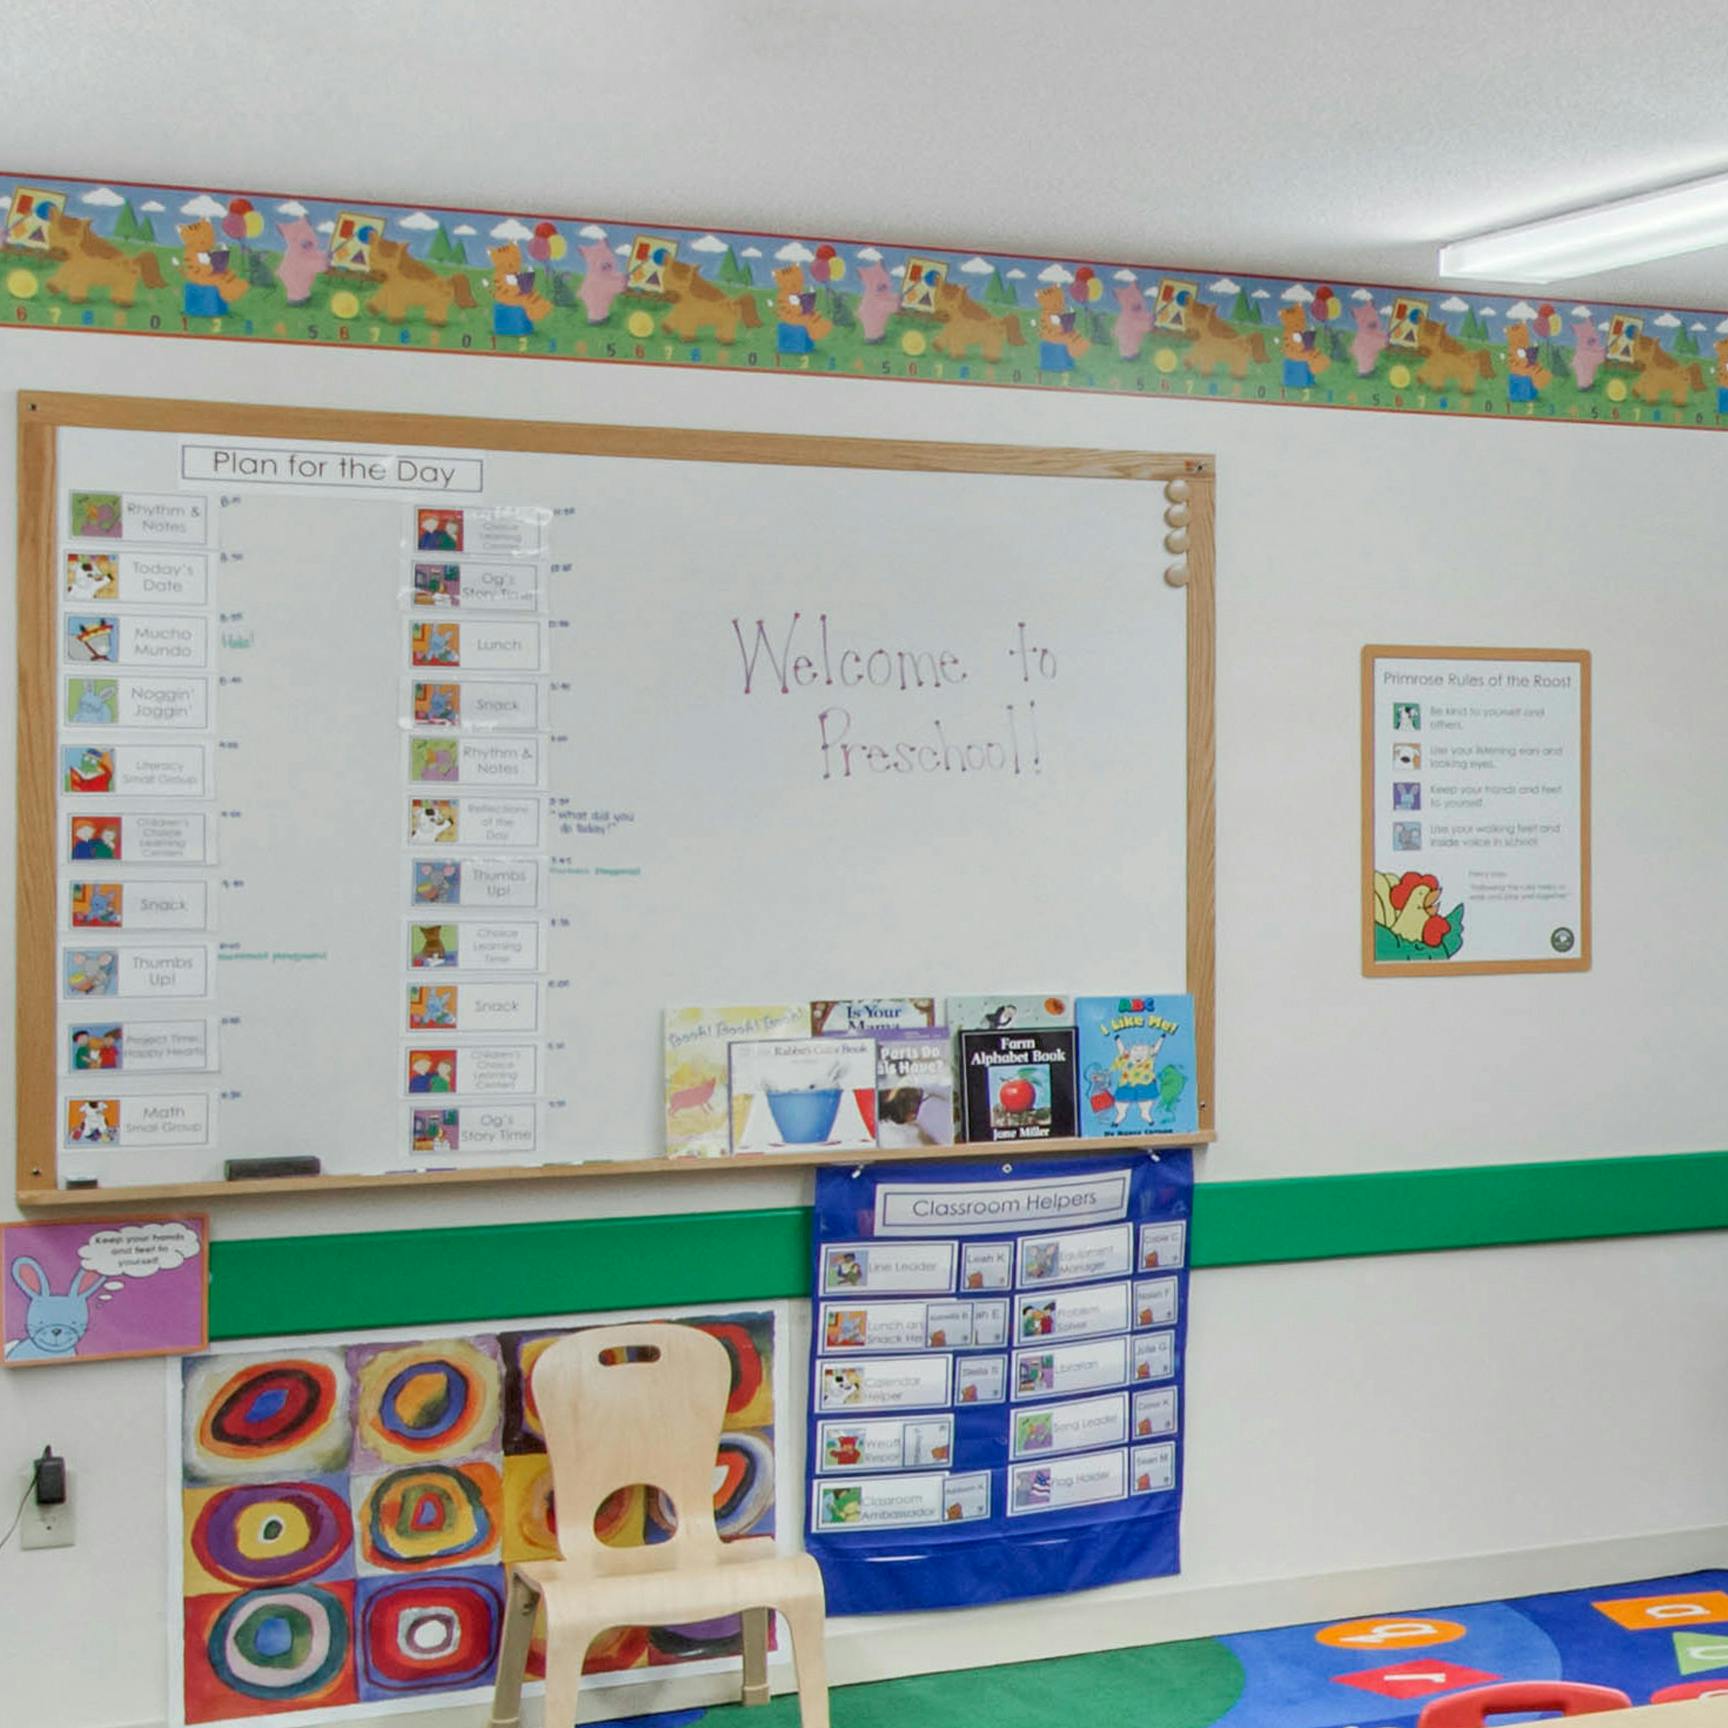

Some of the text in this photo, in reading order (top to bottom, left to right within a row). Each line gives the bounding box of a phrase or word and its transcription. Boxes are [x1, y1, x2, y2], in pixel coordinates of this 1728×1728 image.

[213, 450, 456, 489] Plan for the Day
[127, 501, 186, 518] Rhythm
[143, 519, 187, 534] Notes
[133, 560, 195, 577] Today's
[143, 579, 183, 594] Date
[134, 627, 192, 641] Mucho
[134, 644, 192, 658] Mundo
[477, 638, 521, 651] Lunch
[732, 611, 1058, 695] Welcome to
[1384, 670, 1572, 689] Primrose Rules of the Roost
[475, 699, 519, 712] Snack
[463, 746, 518, 761] Rhythm
[477, 762, 519, 775] Notes
[1476, 823, 1515, 836] walking
[473, 868, 527, 882] Thumbs
[140, 898, 189, 912] Snack
[133, 956, 193, 969] Thumbs
[474, 999, 519, 1013] Snack
[846, 1005, 902, 1019] Is Your
[1111, 1014, 1145, 1031] Like
[920, 1044, 940, 1058] Do
[1001, 1037, 1035, 1051] Farm
[970, 1048, 1067, 1067] Alphabet Book
[143, 1106, 186, 1119] Math
[461, 1129, 496, 1144] Story
[993, 1126, 1050, 1141] Jane Miller
[912, 1191, 1097, 1217] Classroom Helpers
[95, 1235, 124, 1247] Keep
[126, 1234, 150, 1245] your
[869, 1260, 937, 1273] Line Leader
[867, 1320, 904, 1332] Lunch
